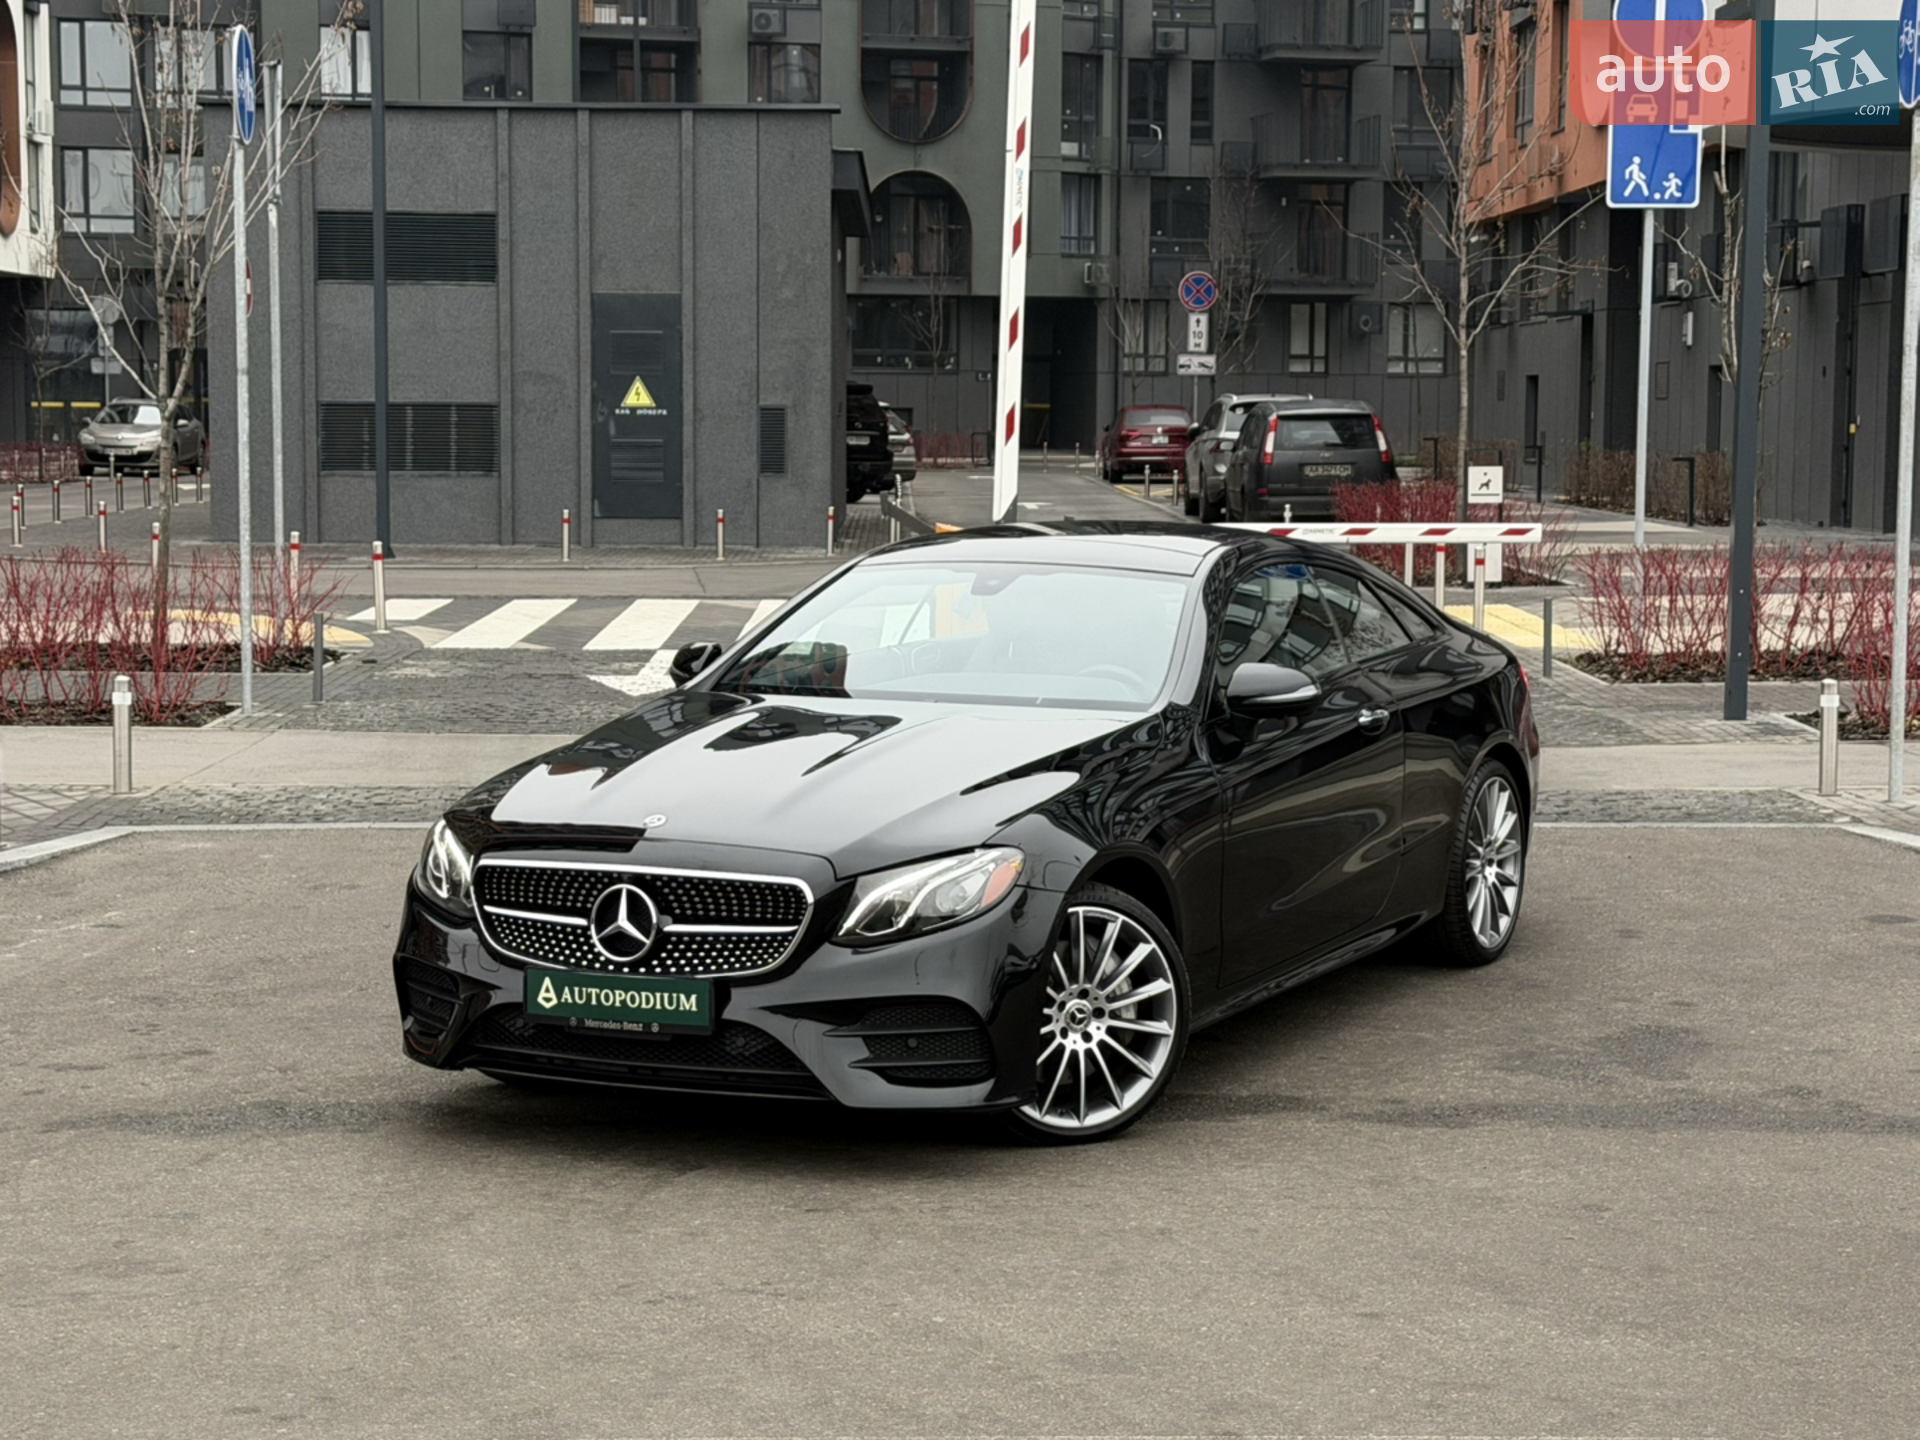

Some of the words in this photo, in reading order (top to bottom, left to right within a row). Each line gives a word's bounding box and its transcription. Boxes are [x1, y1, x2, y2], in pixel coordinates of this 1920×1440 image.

[1192, 330, 1203, 340] 10
[560, 985, 698, 1012] AUTOPODIUM
[584, 1018, 644, 1032] Mercedes-Benz
